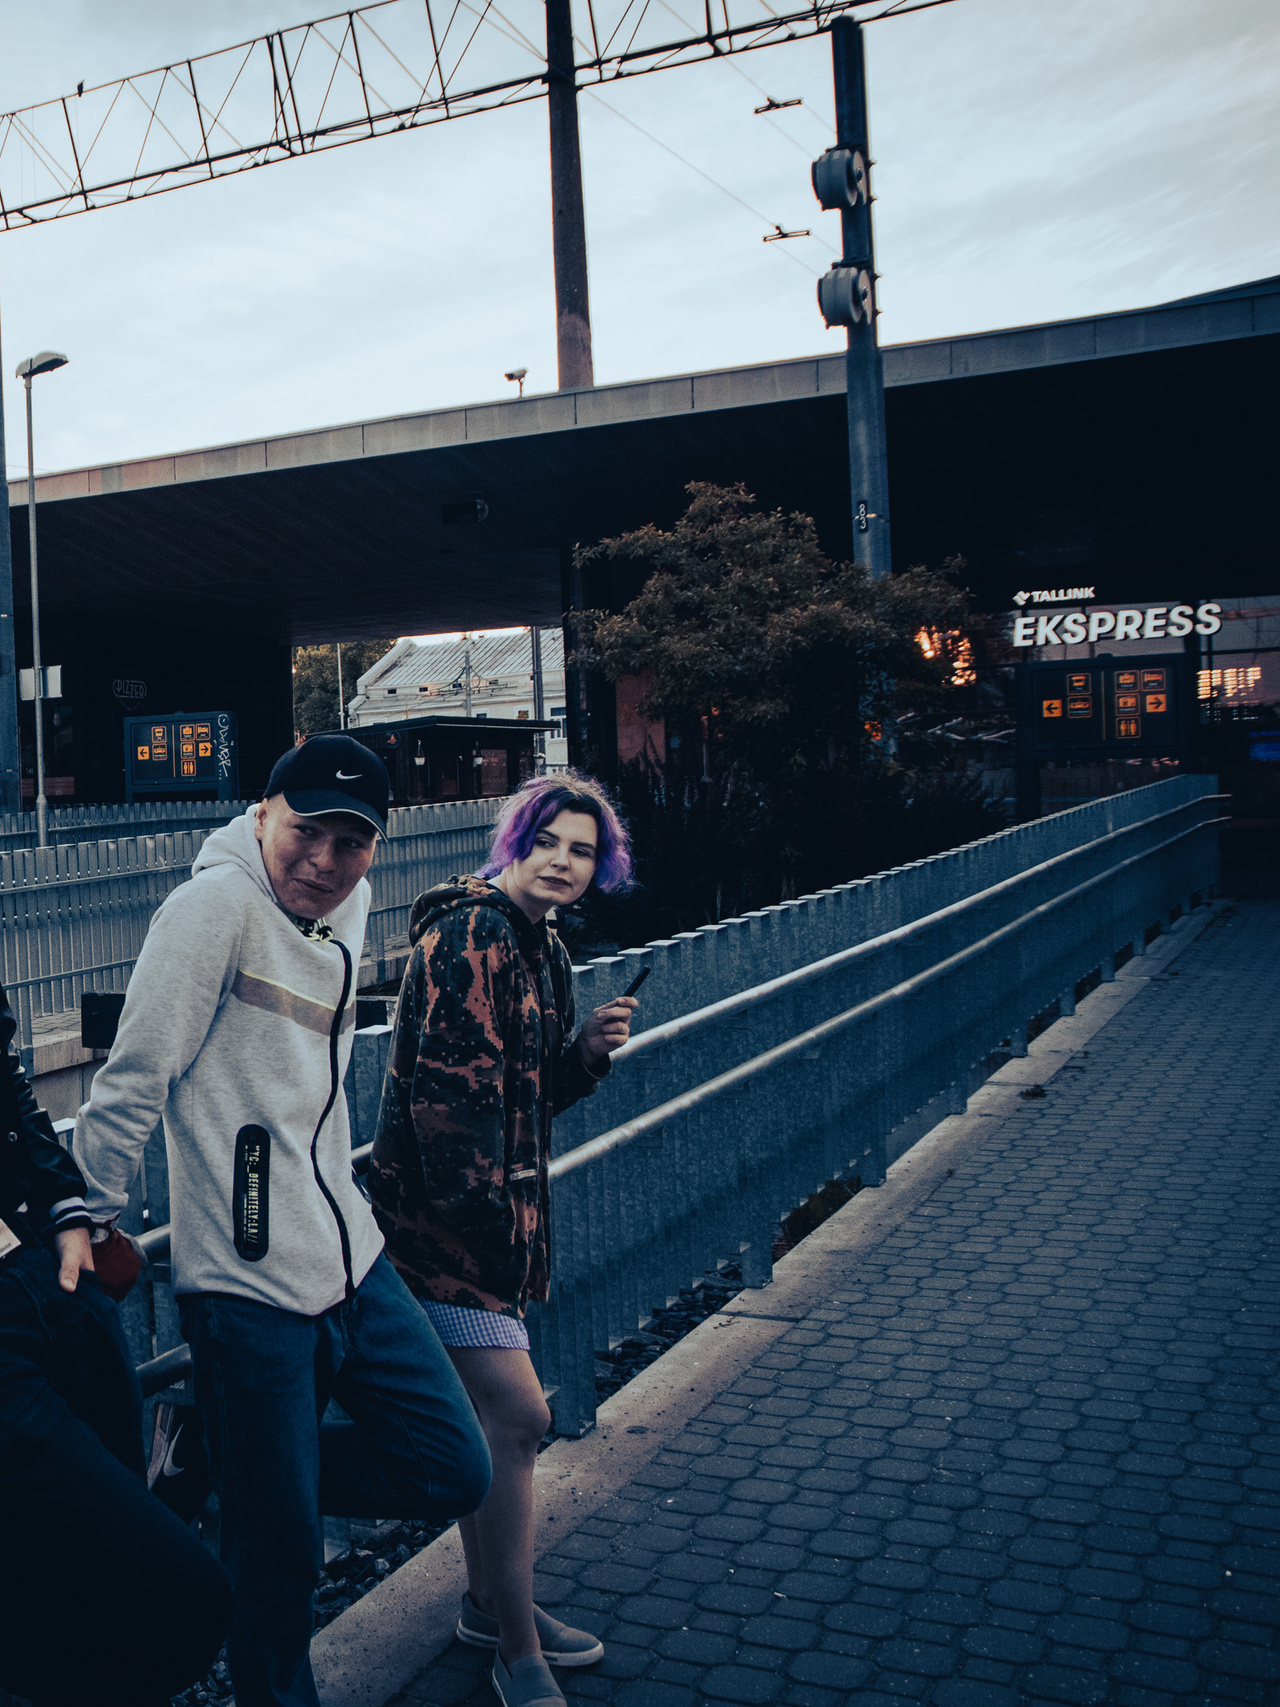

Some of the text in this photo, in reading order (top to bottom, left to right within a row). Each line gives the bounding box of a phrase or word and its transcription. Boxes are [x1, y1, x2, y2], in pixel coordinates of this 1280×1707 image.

[858, 502, 868, 530] 83
[1031, 586, 1096, 603] TALLINK
[1012, 602, 1222, 648] EKSPRESS
